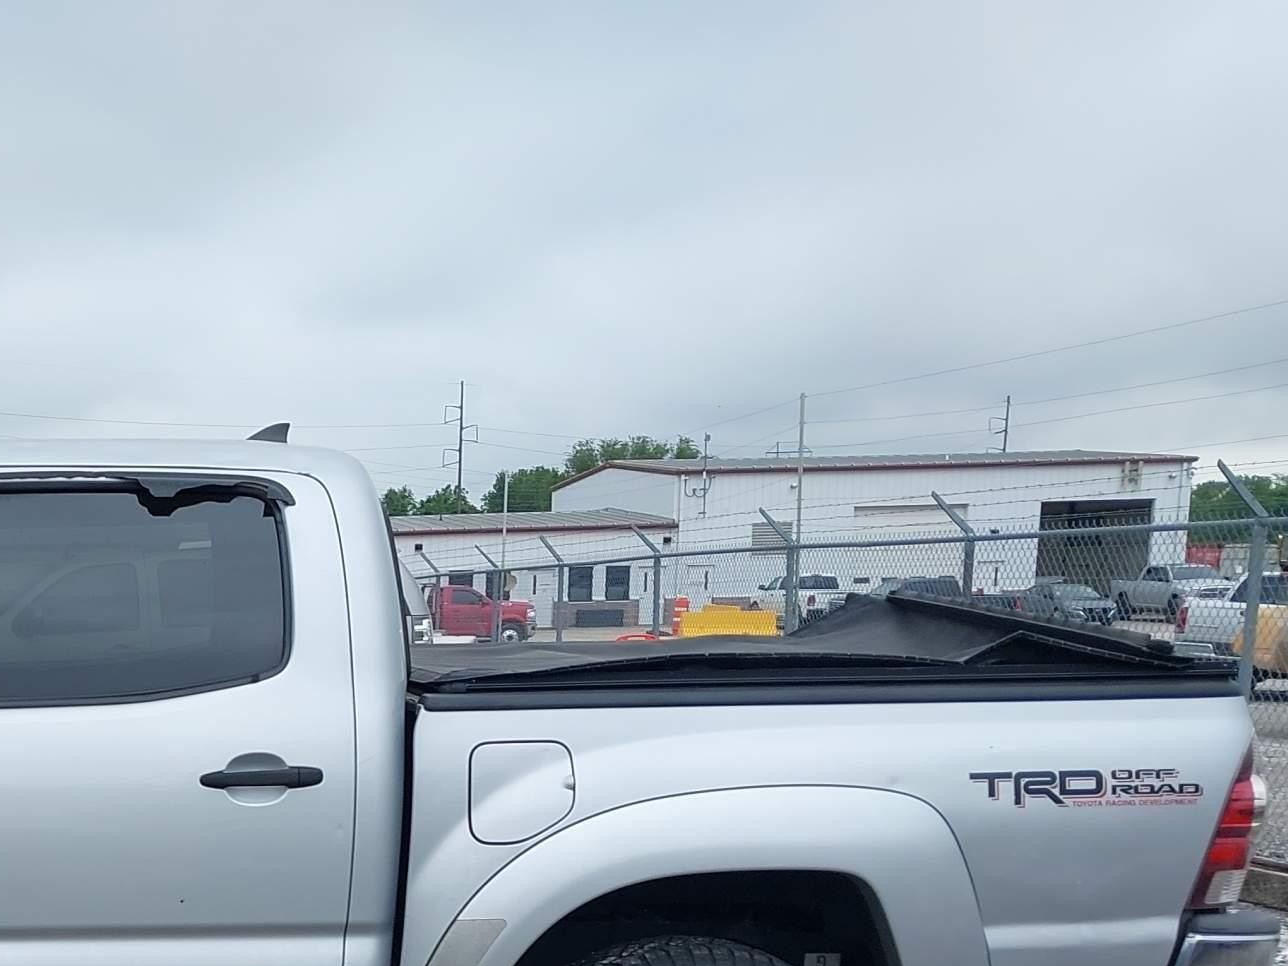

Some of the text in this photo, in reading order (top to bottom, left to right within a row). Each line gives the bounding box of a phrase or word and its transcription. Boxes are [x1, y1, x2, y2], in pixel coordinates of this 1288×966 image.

[1111, 768, 1180, 783] OFF
[969, 769, 1108, 808] TRD
[1111, 783, 1203, 798] ROAD
[1105, 799, 1136, 807] RACING
[1138, 798, 1198, 806] DEVELOPMENT
